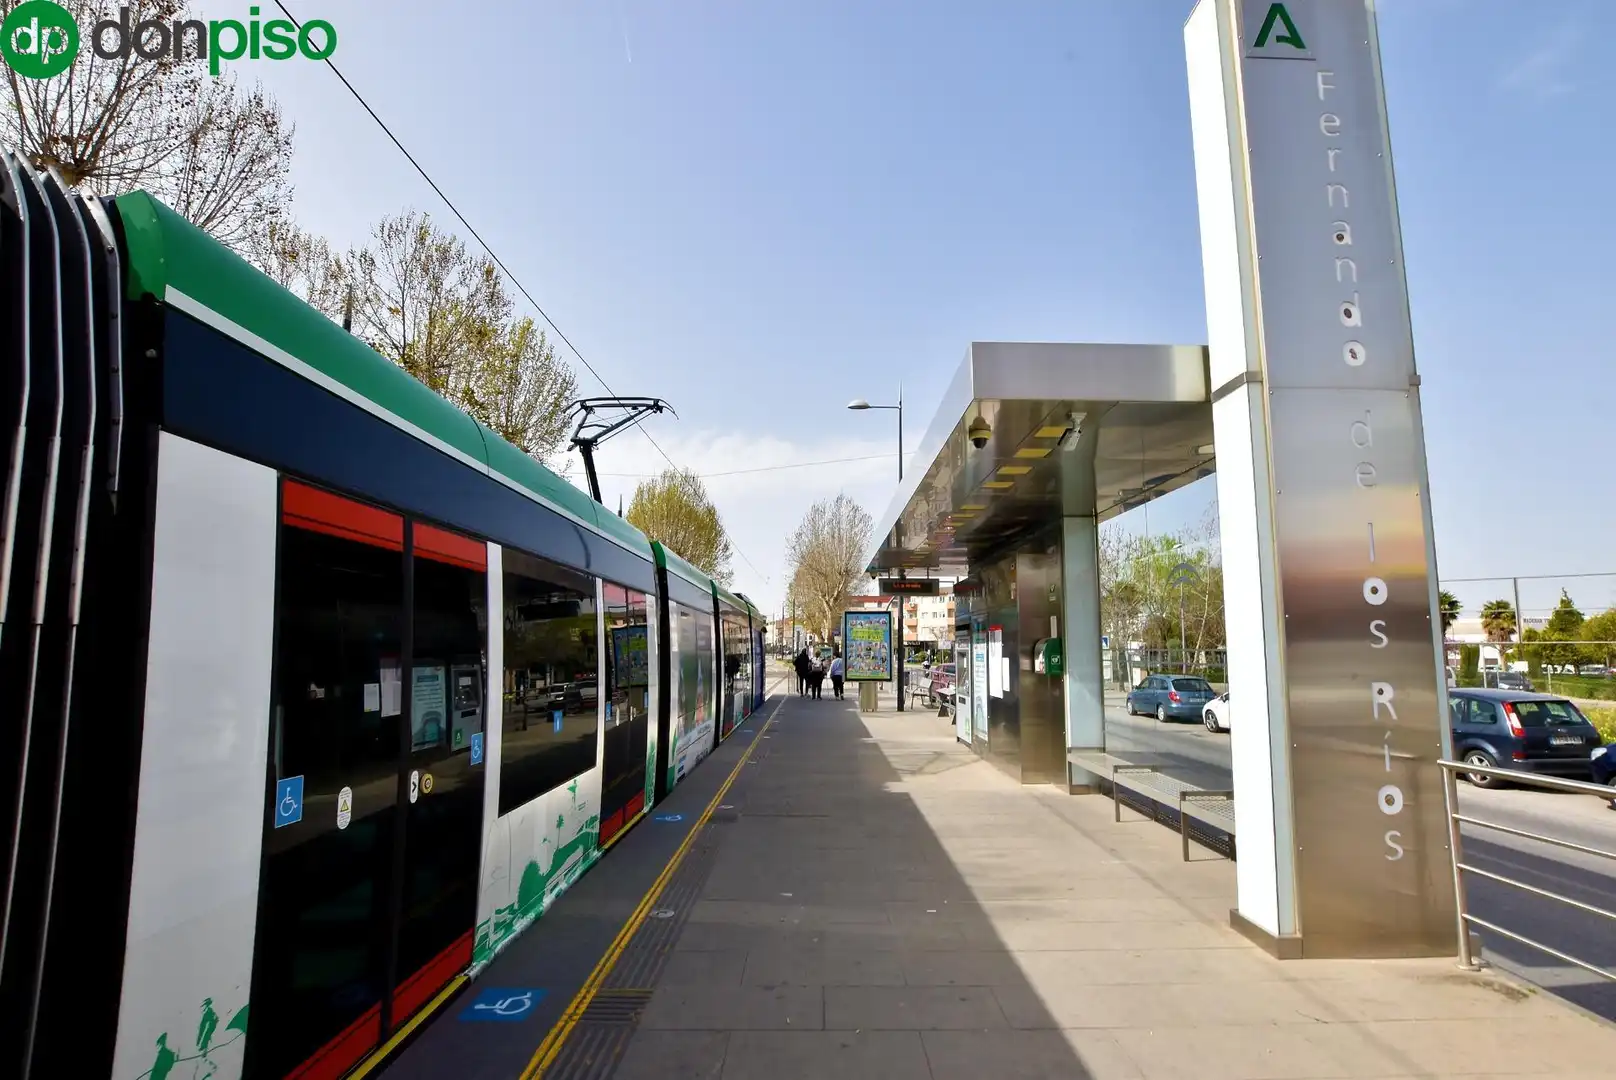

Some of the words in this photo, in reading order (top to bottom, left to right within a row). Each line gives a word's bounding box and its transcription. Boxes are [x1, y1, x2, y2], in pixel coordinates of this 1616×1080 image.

[1316, 71, 1366, 366] Fernando
[1351, 410, 1377, 488] de
[1363, 522, 1388, 648] los
[1372, 682, 1403, 861] Ríos
